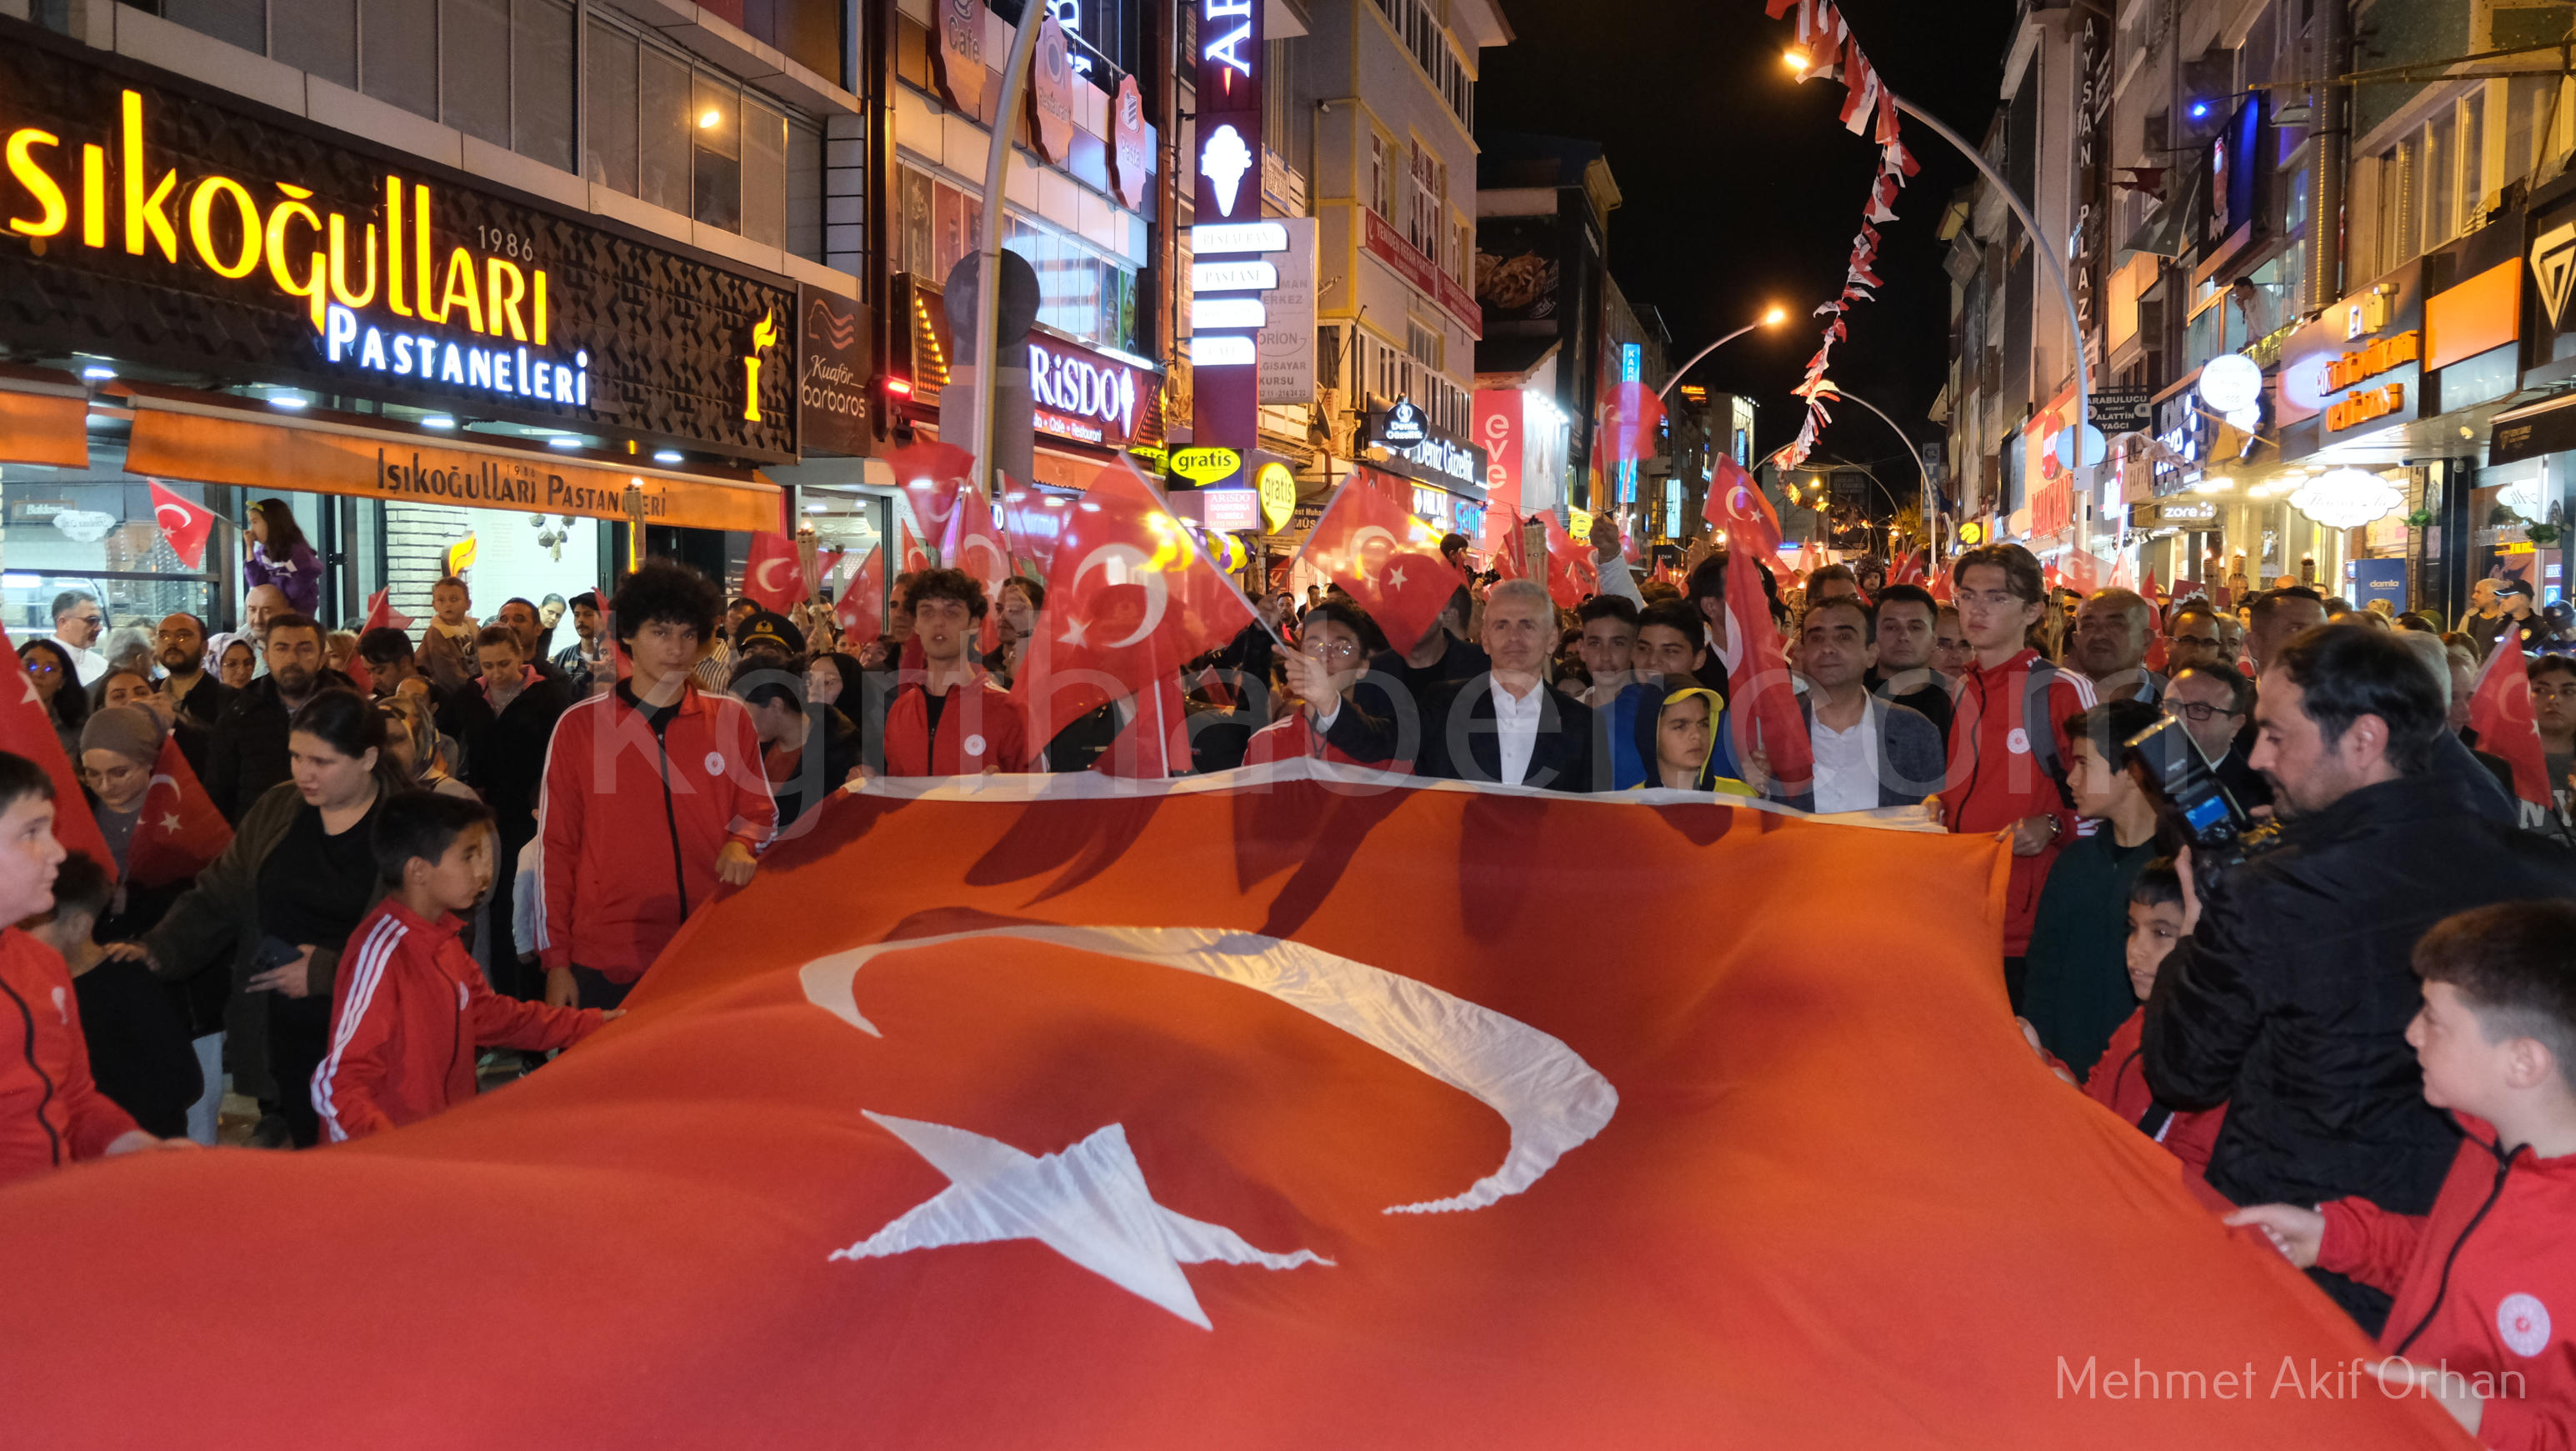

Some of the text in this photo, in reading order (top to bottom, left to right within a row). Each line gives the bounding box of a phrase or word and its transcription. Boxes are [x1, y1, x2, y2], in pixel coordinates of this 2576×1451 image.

[948, 15, 981, 65] Cafe
[2081, 18, 2094, 167] AYSAN
[1038, 86, 1073, 127] Restaurant
[1121, 136, 1141, 169] Pasta
[478, 224, 534, 263] 1986
[1205, 269, 1261, 283] PASTANE
[1281, 280, 1308, 289] MAN
[1263, 295, 1303, 304] ERKEZ
[811, 354, 855, 386] Kuaför
[802, 369, 865, 418] barbaros
[1386, 430, 1423, 440] Güzellik
[1391, 422, 1418, 431] Deniz
[2102, 422, 2128, 430] YAĞCI
[1178, 451, 1231, 472] gratis
[1418, 438, 1473, 483] Deniz Güzellik
[1265, 477, 1292, 506] gratis
[1306, 507, 1323, 516] Muha
[2164, 507, 2198, 518] zore
